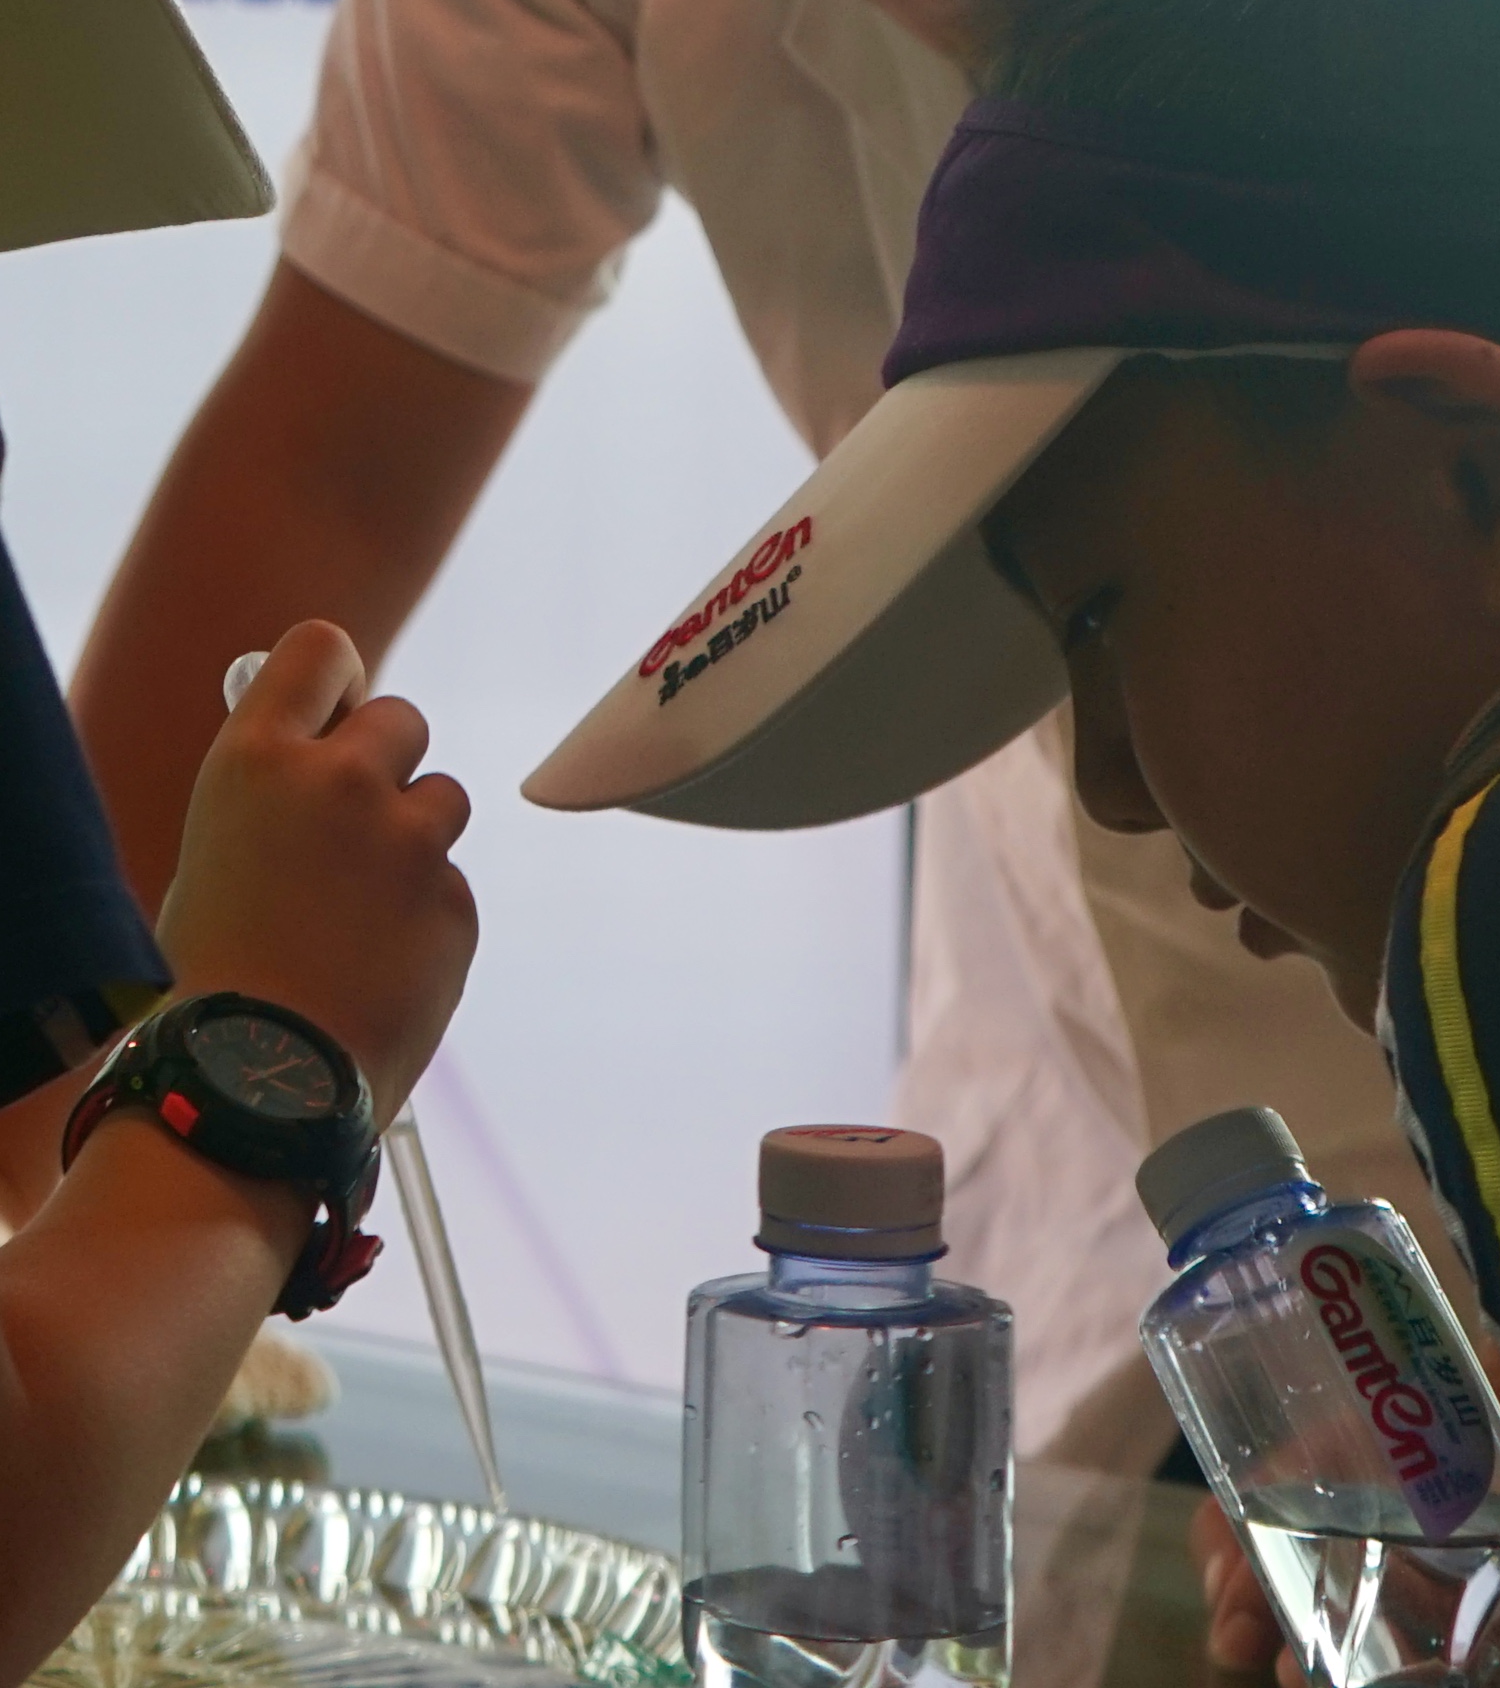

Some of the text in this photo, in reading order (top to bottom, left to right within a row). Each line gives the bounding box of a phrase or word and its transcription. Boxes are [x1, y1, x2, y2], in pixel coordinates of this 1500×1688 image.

[638, 515, 812, 678] Ganten
[1299, 1243, 1440, 1483] Ganten
[1407, 1314, 1482, 1429] 百岁山
